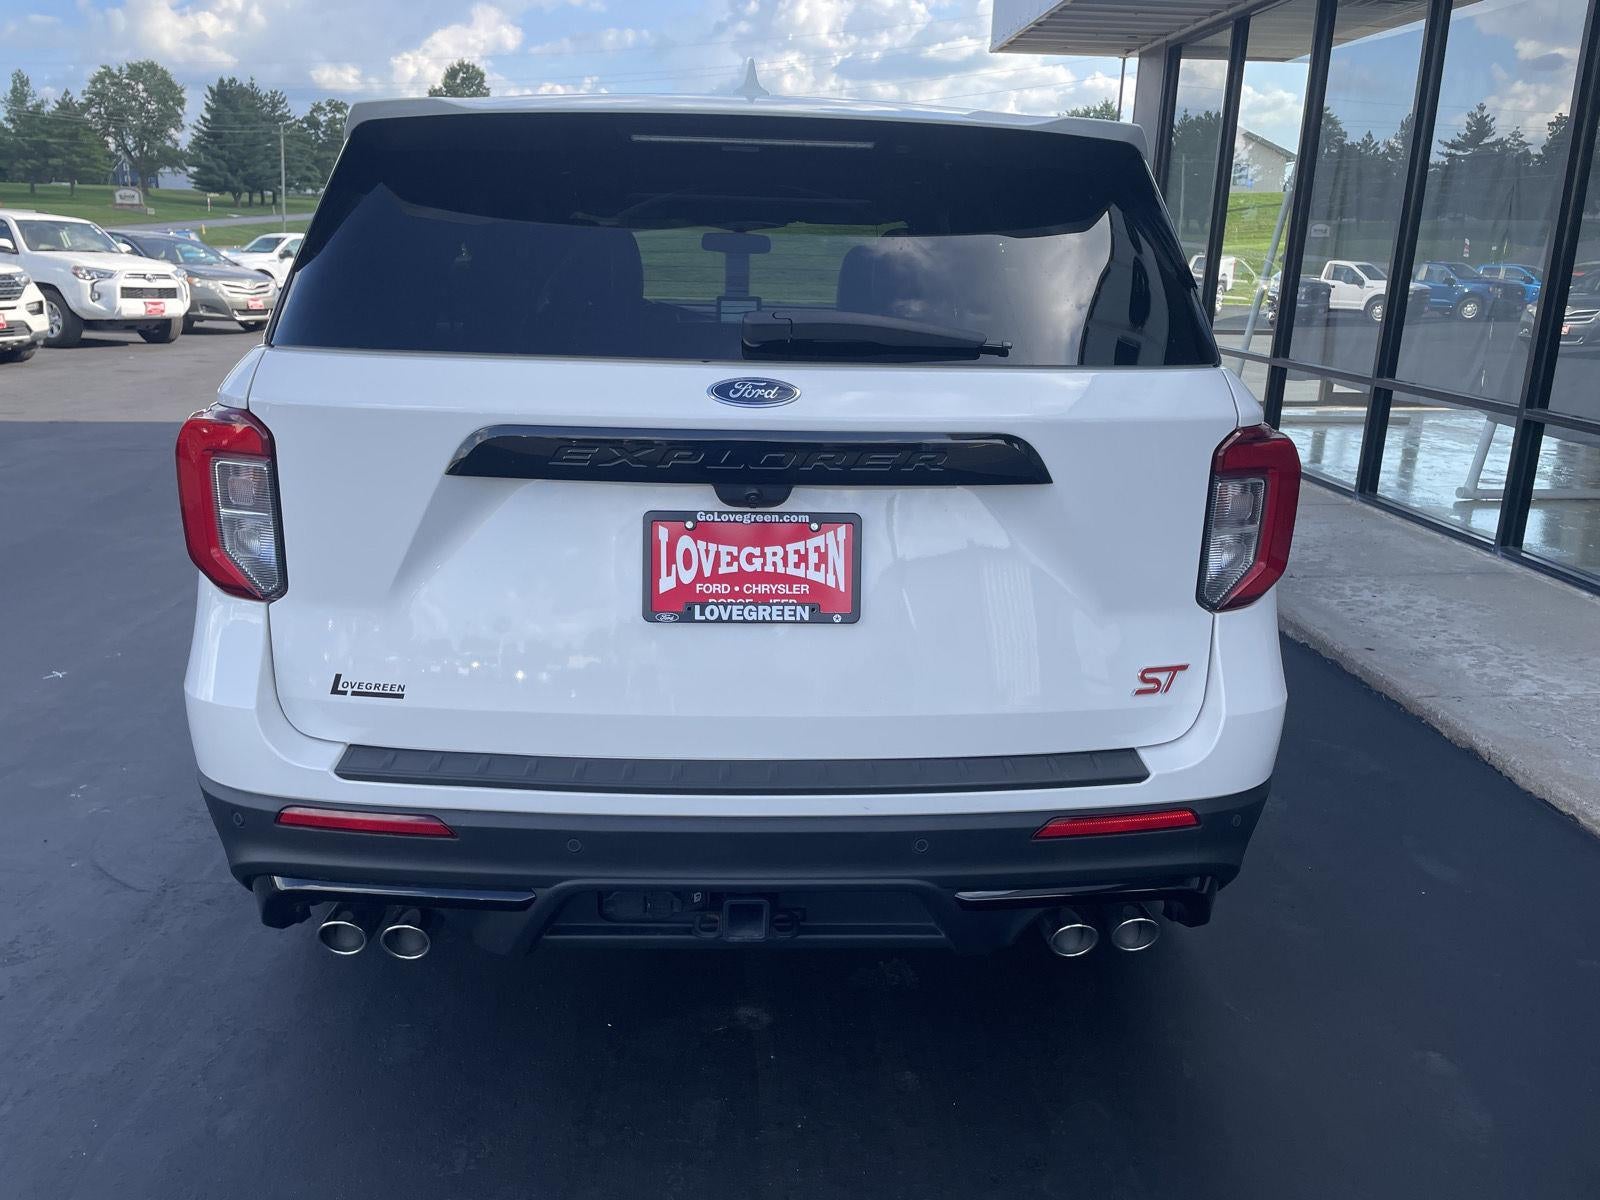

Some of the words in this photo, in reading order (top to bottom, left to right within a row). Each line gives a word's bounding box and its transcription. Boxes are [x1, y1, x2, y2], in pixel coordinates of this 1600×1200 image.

[729, 381, 779, 399] Ford
[549, 445, 948, 471] EXPLORER
[696, 511, 810, 524] GoLovegreen.com
[658, 524, 846, 595] LOVEGREEN
[696, 583, 731, 594] FORD
[743, 583, 810, 595] CHRYSLER
[694, 604, 810, 621] LOVEGREEN
[330, 673, 406, 696] LOVEGREEN
[1133, 664, 1190, 696] ST
